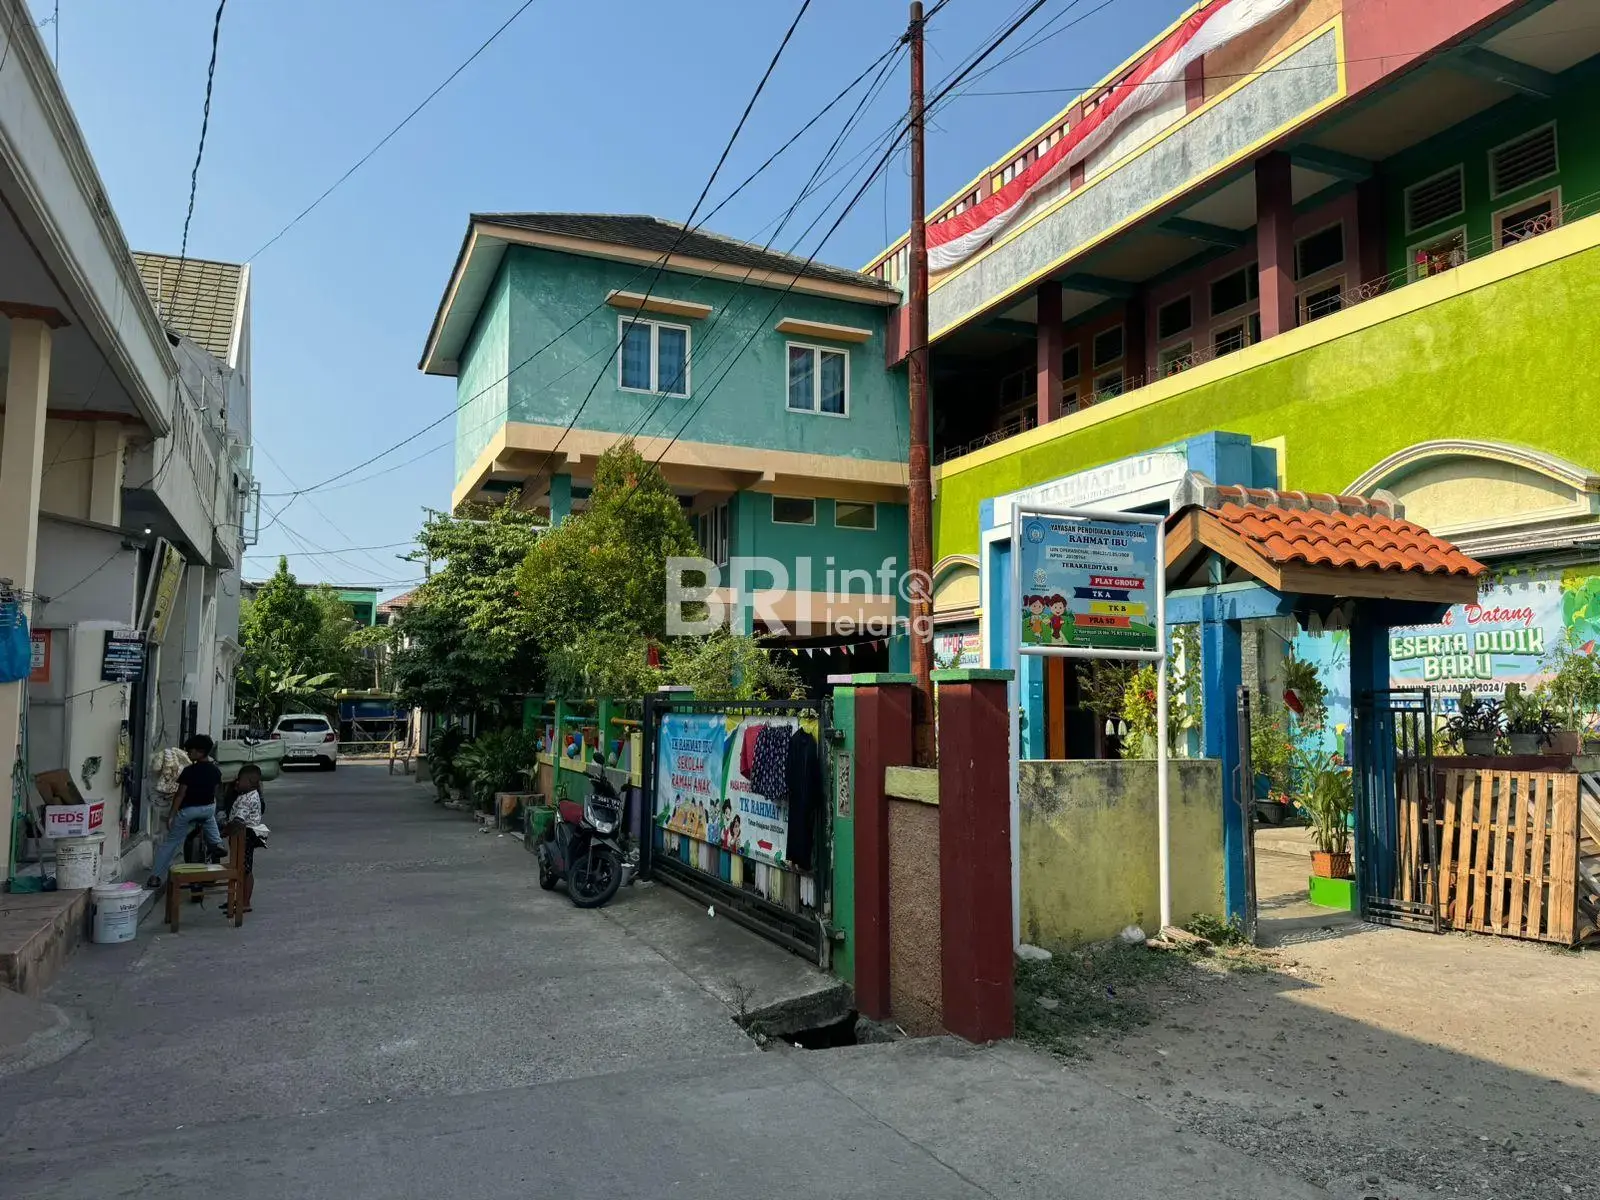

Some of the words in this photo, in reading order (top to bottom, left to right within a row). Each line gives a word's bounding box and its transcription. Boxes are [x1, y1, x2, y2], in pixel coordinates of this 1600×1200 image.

[1051, 524, 1076, 532] YAYASAN
[1077, 526, 1111, 535] PENDIDIKAN
[1125, 530, 1145, 539] SOSIAL
[1069, 535, 1110, 546] RAHMAT
[1111, 539, 1128, 547] IBU
[1062, 562, 1113, 571] TERAKREDITASI
[1095, 577, 1114, 585] PLAY
[1114, 579, 1140, 587] GROUP
[1105, 617, 1115, 625] SD
[1464, 604, 1535, 626] Datang
[1390, 632, 1469, 661] ESERTA
[1474, 627, 1545, 655] DIDIK
[1424, 653, 1493, 681] BARU
[677, 755, 705, 772] SEKOLAH
[671, 773, 693, 791] RAMAH
[694, 777, 712, 796] ANAK
[49, 811, 85, 823] TED'S
[739, 797, 750, 812] TK
[750, 799, 781, 821] RAHMAT
